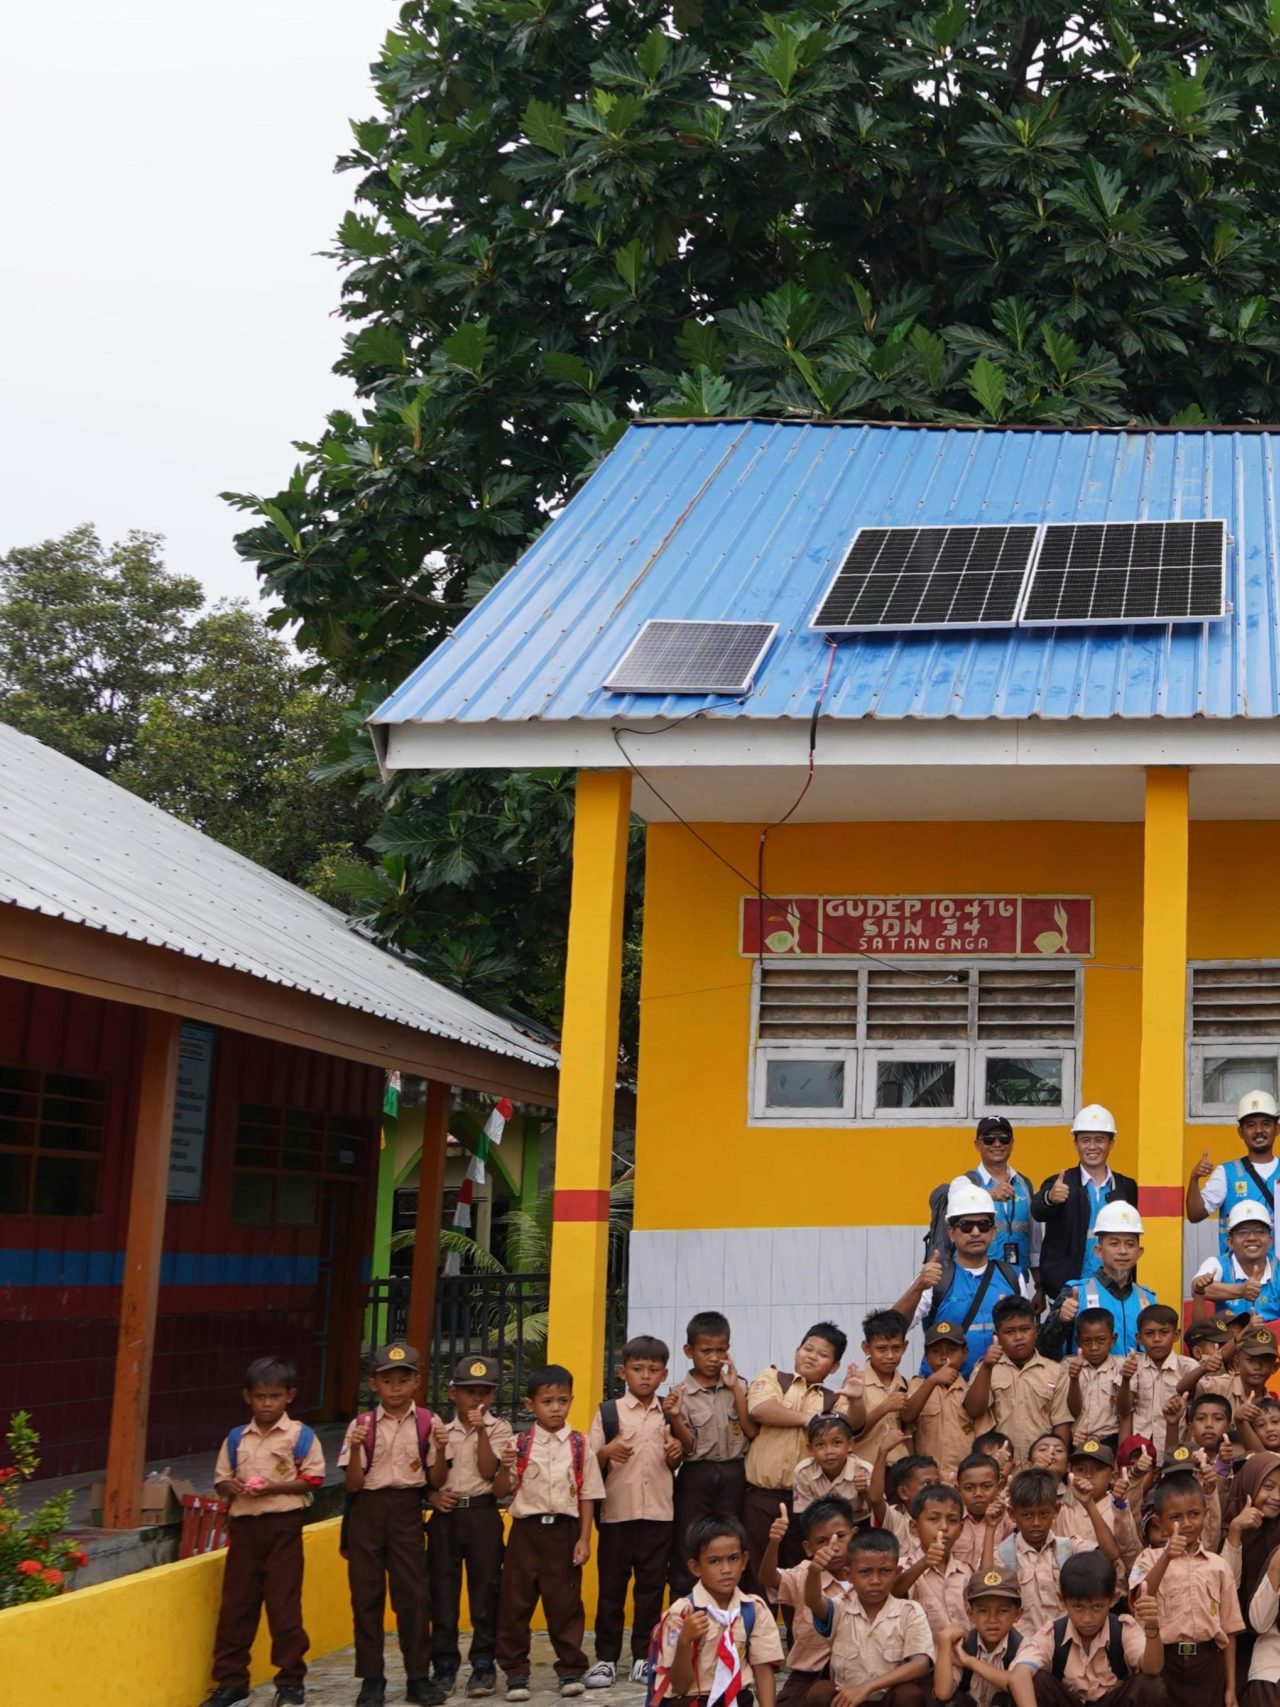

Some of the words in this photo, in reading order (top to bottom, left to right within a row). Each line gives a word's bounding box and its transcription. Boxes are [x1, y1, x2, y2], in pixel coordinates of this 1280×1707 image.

[825, 899, 921, 918] GUDEP
[863, 918, 923, 937] SDN
[942, 918, 981, 937] 34
[859, 937, 989, 951] SATANGNGA
